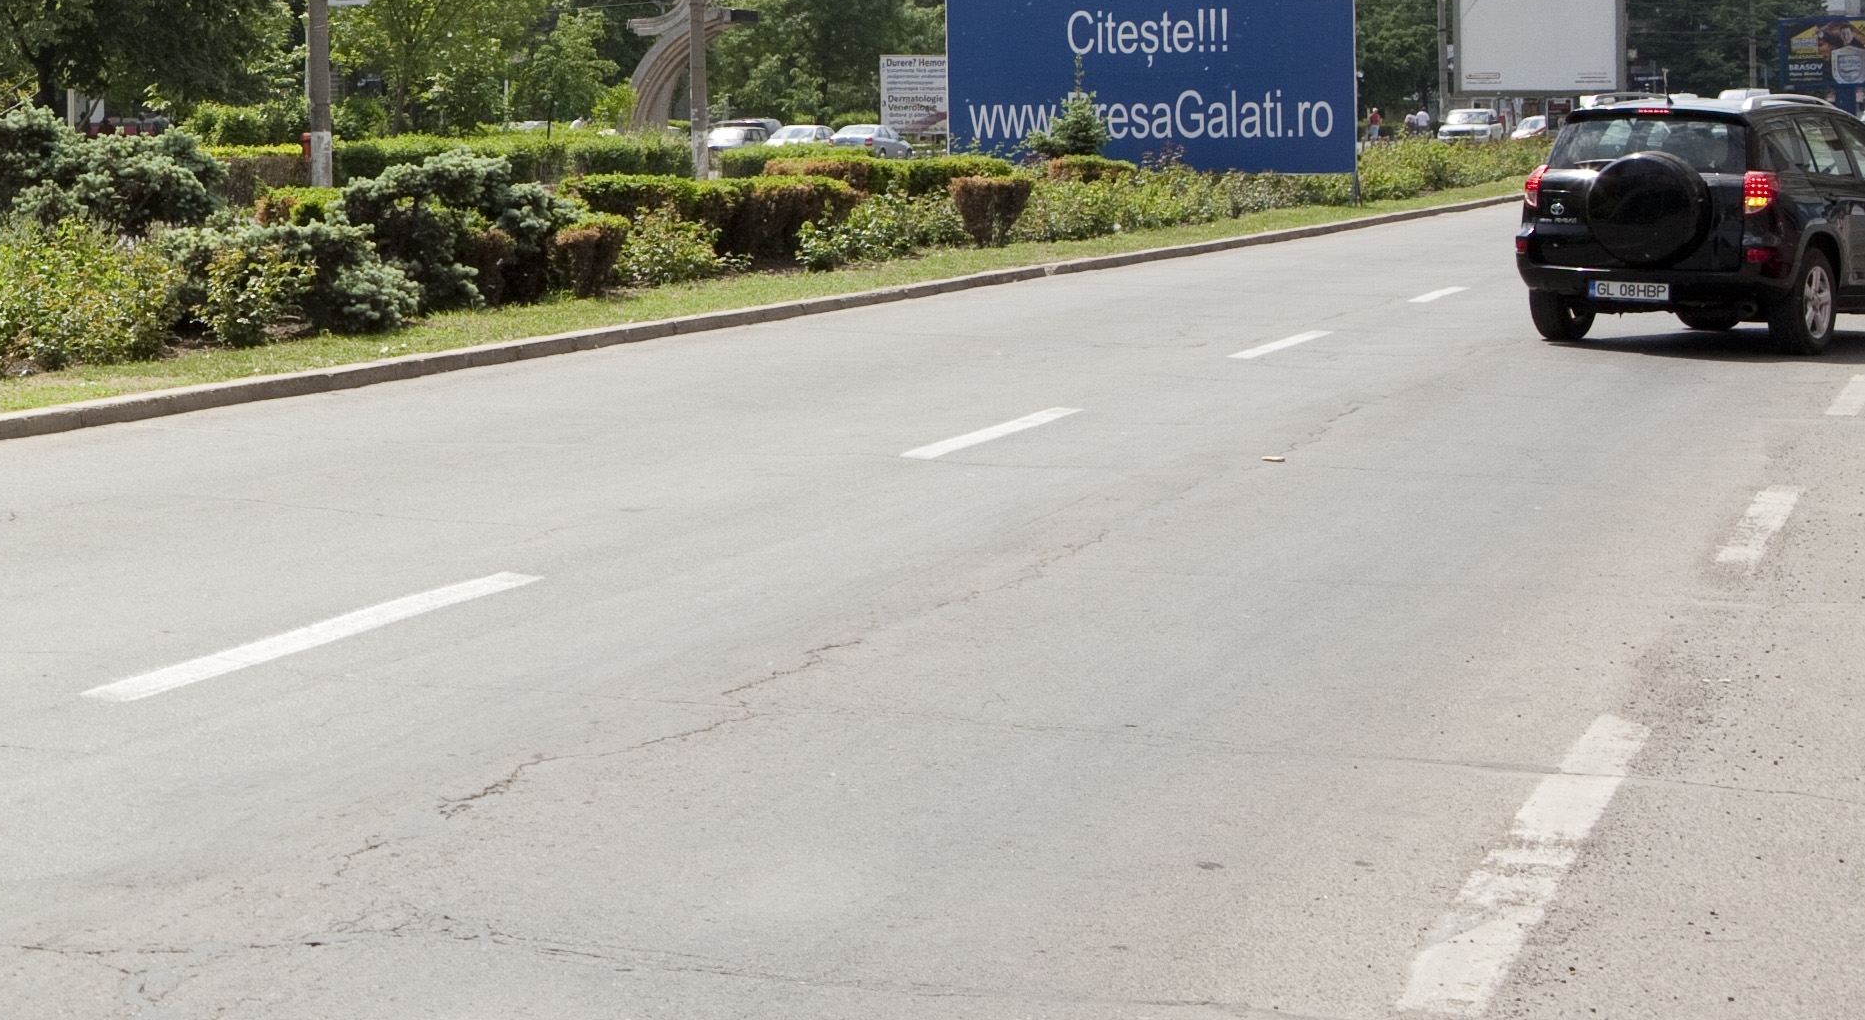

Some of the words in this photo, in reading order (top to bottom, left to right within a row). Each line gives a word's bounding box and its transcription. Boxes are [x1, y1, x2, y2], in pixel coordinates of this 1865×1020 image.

[1066, 8, 1229, 68] Citește!!!
[887, 94, 944, 104] Dermatologie
[887, 103, 938, 112] Venerologie
[1596, 282, 1615, 296] GL
[1619, 283, 1667, 298] 08HBP
